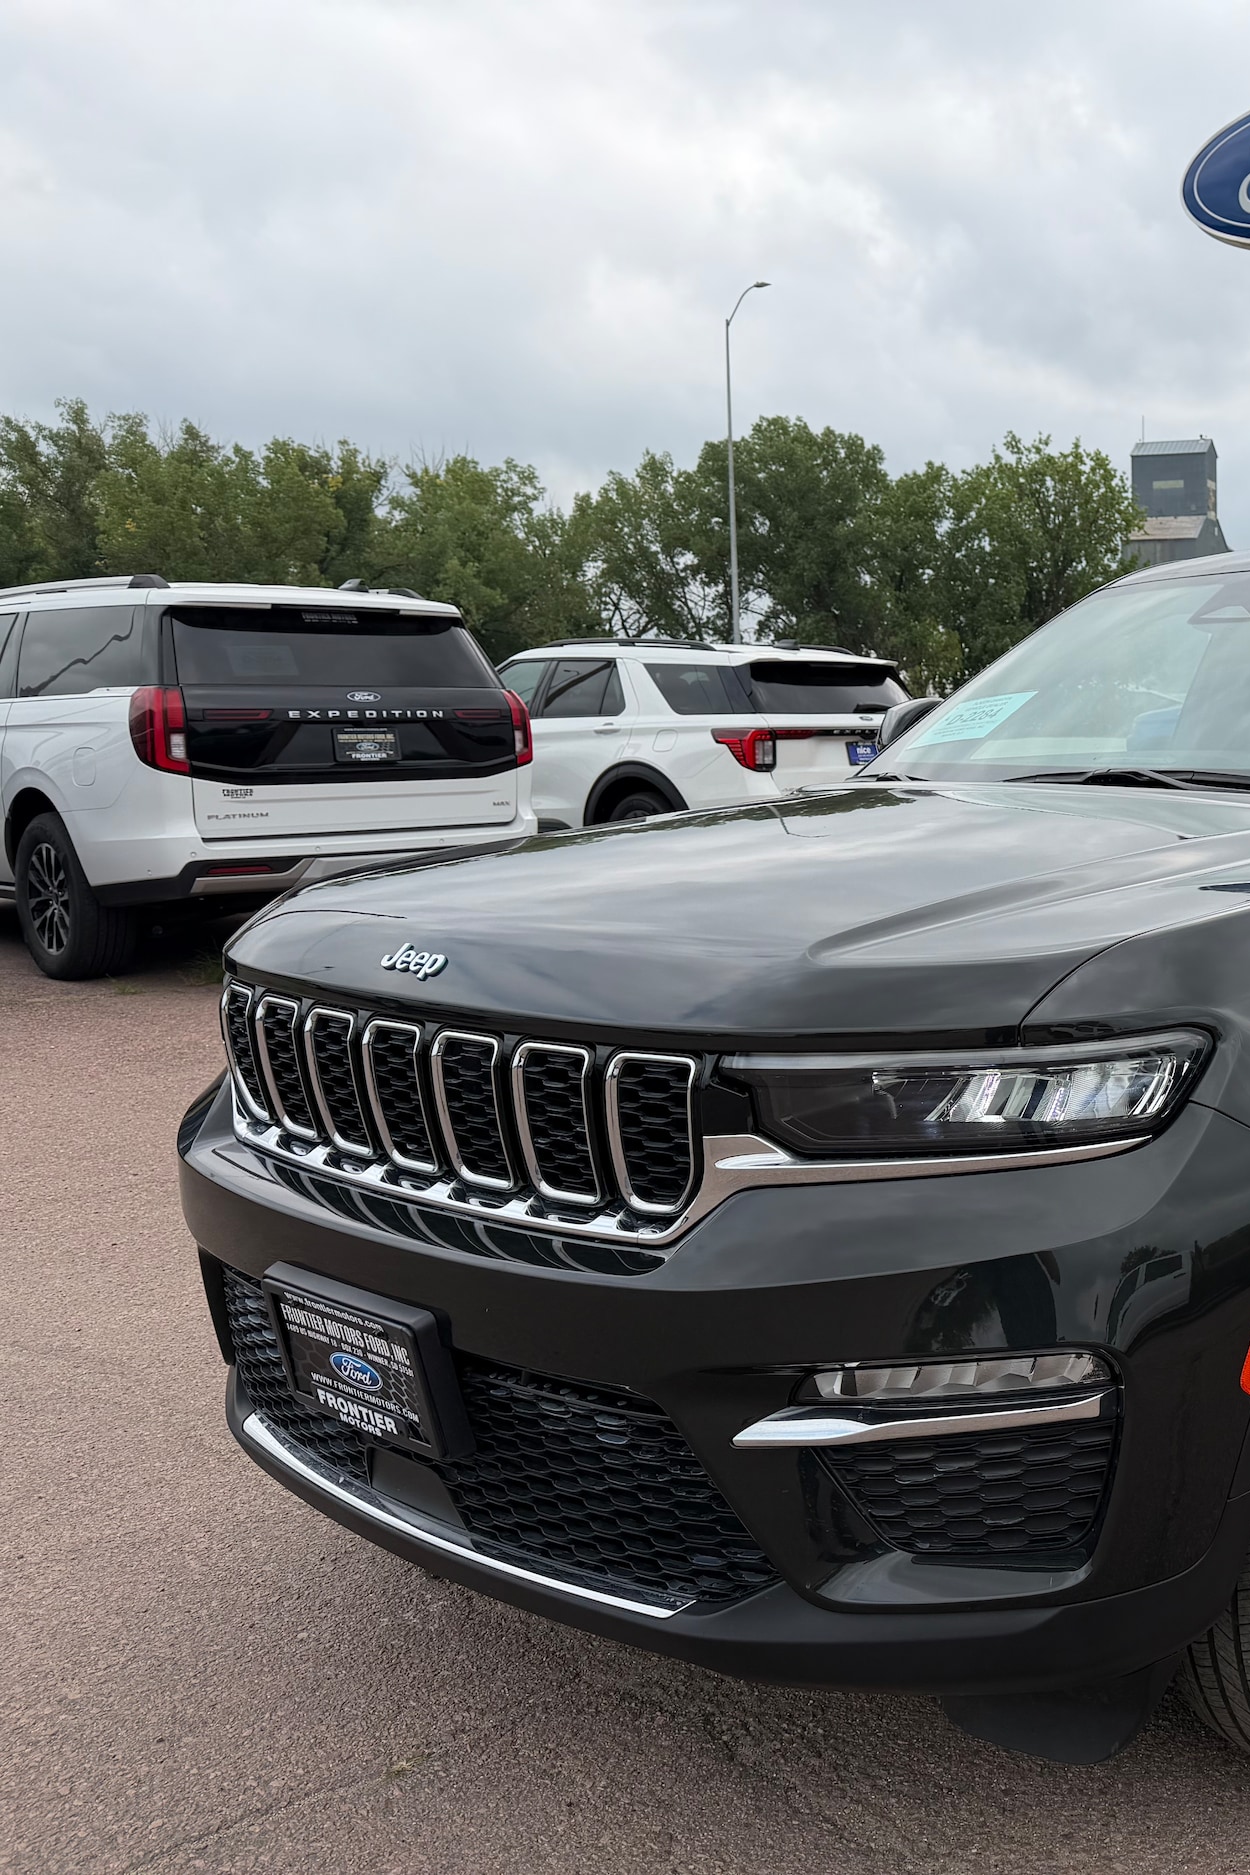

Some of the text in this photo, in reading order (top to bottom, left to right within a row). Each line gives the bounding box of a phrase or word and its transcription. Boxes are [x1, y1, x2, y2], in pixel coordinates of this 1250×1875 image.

[288, 710, 444, 719] EXPEDITION
[946, 707, 1004, 726] D-2284
[207, 812, 269, 820] PLATINUM
[380, 942, 449, 981] Jeep
[280, 1303, 326, 1333] FRONTIER
[323, 1318, 365, 1348] MOTORS
[284, 1292, 385, 1332] www.frontiermotors.com
[340, 1357, 373, 1386] Ford
[311, 1372, 420, 1423] WWW.FRONTIERMOTORS.COM
[317, 1388, 399, 1435] FRONTIER
[339, 1412, 383, 1437] MOTORS
